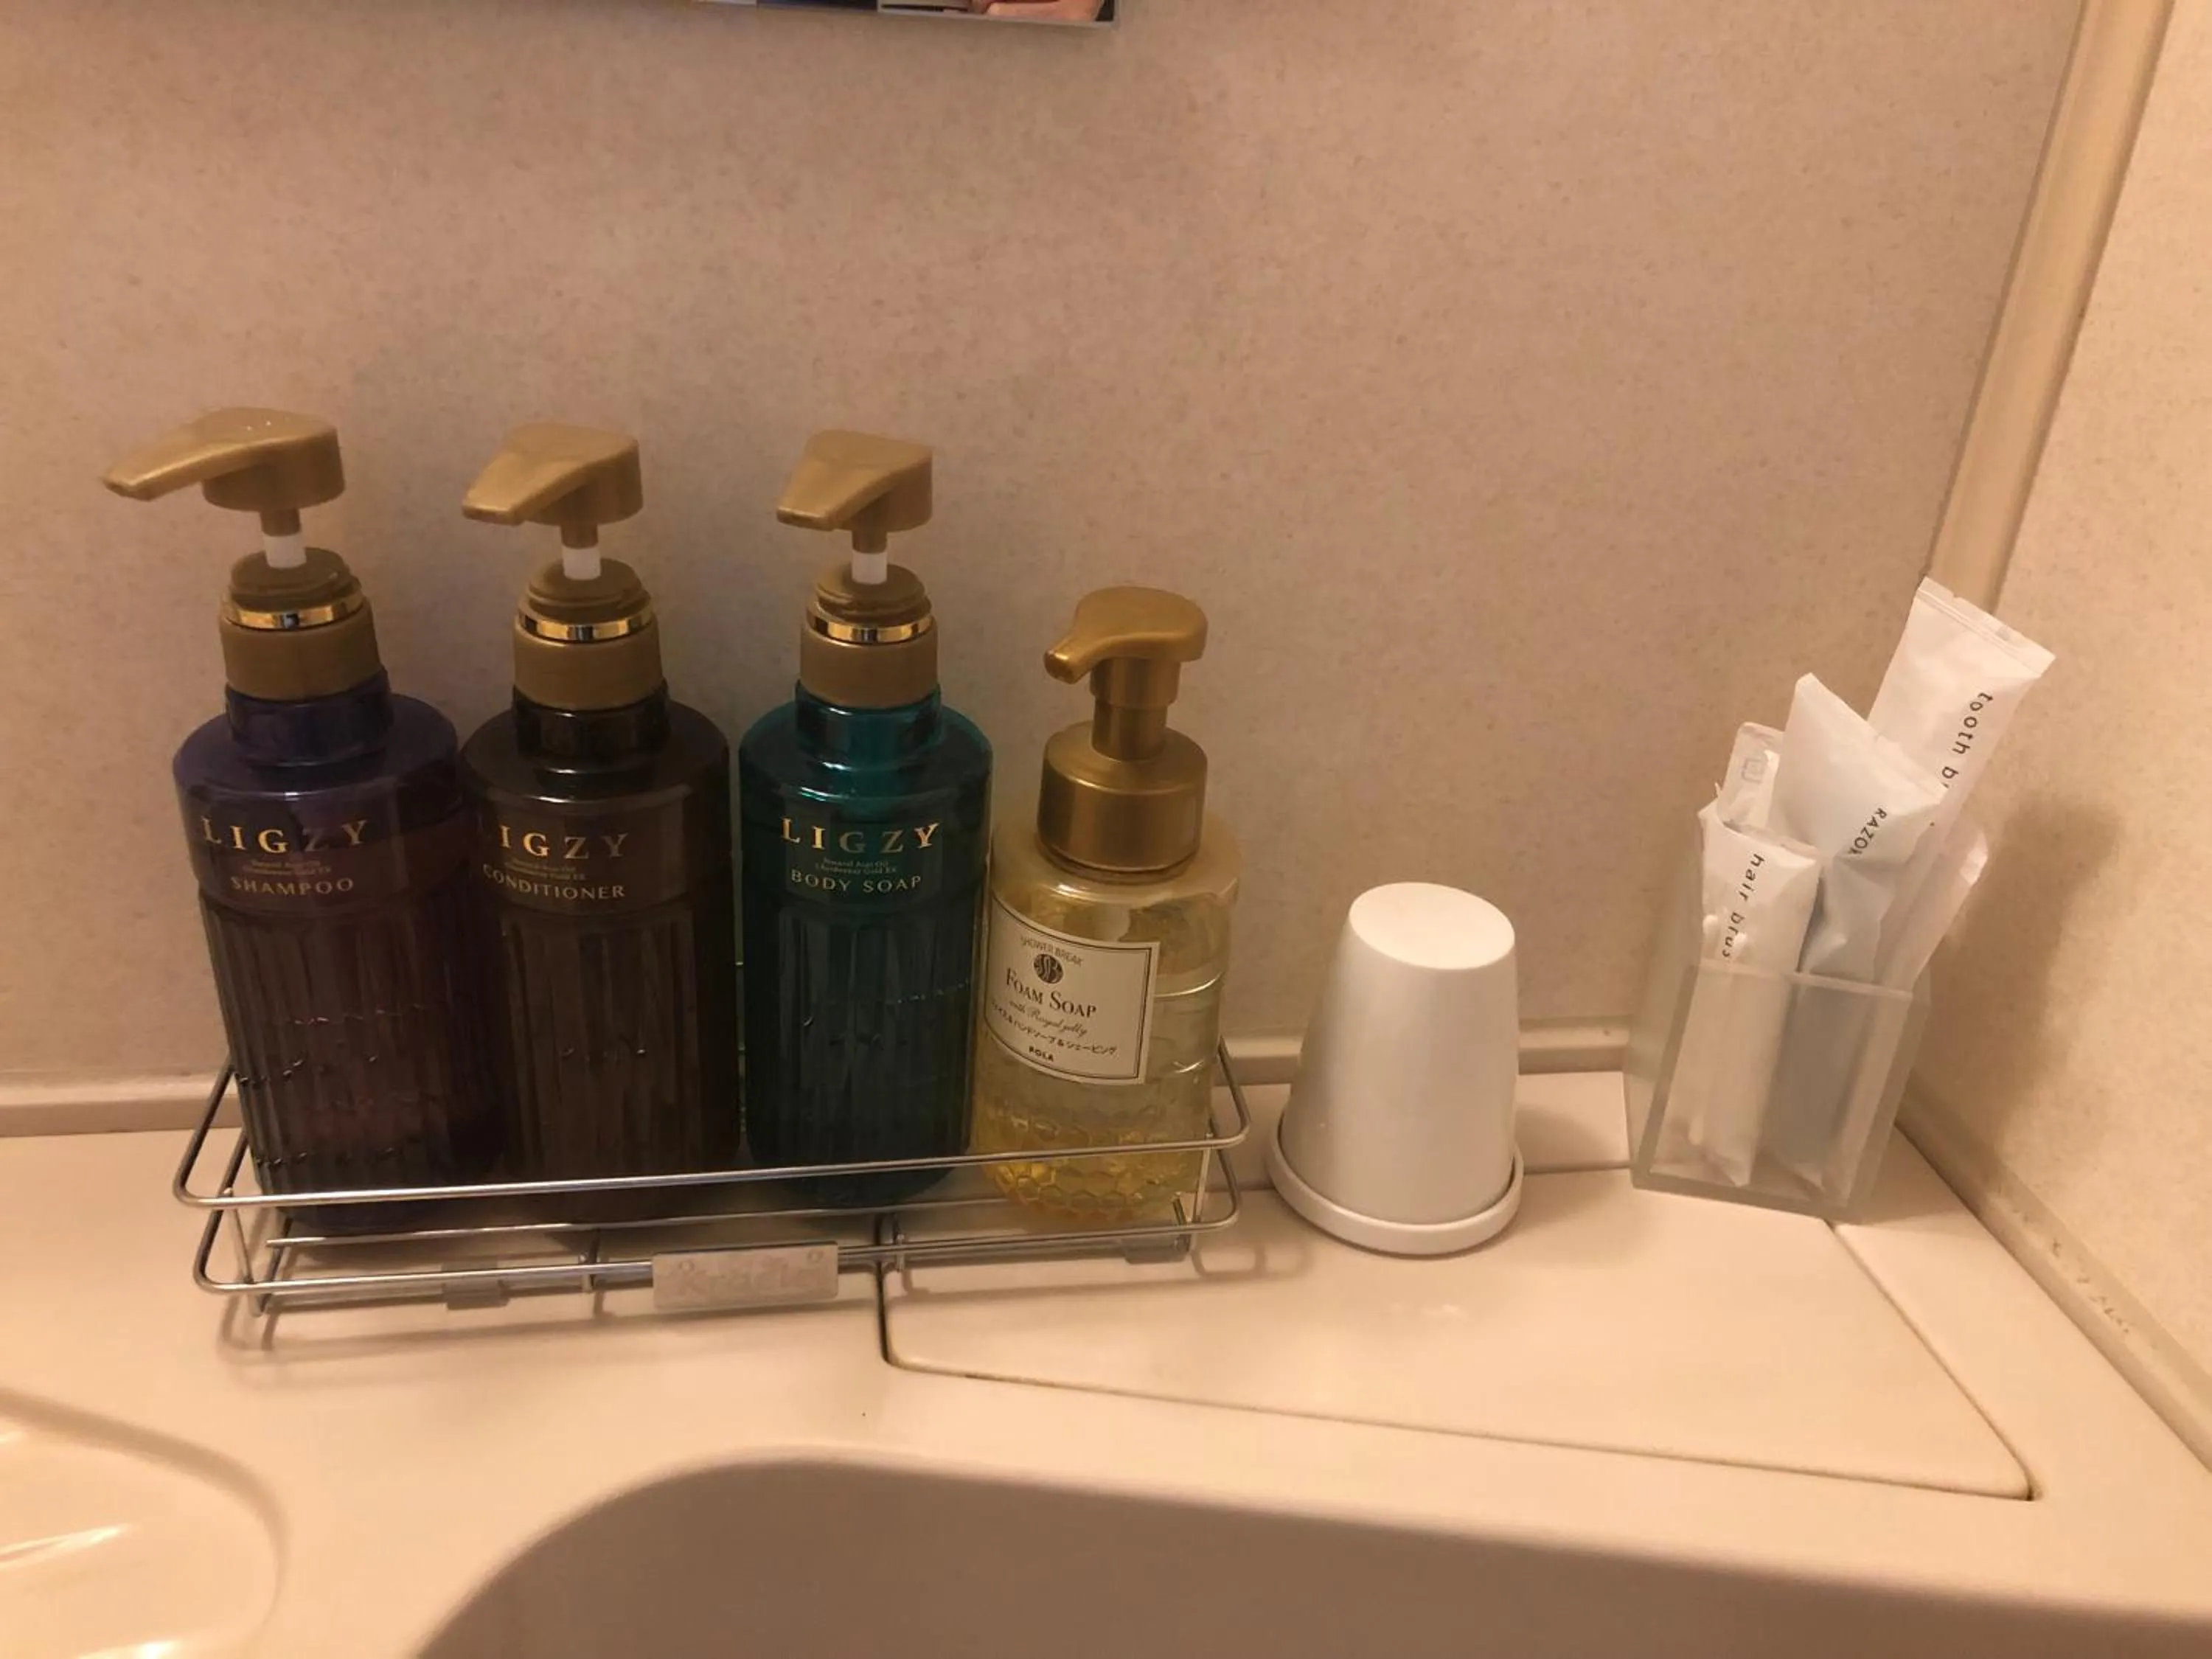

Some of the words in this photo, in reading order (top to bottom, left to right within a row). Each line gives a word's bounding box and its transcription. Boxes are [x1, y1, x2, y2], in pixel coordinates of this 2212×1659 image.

[1952, 692, 1994, 755] tooth
[201, 815, 368, 854] LIGZY
[498, 824, 628, 860] IGZY
[781, 816, 940, 854] LIGZY
[231, 875, 355, 896] SHAMPOO
[482, 863, 627, 900] CONDITIONER
[790, 869, 852, 892] BODY
[863, 875, 921, 894] SOAP
[1738, 853, 1766, 902] hair
[1006, 967, 1043, 1005] FOAM
[1049, 990, 1097, 1019] SOAP
